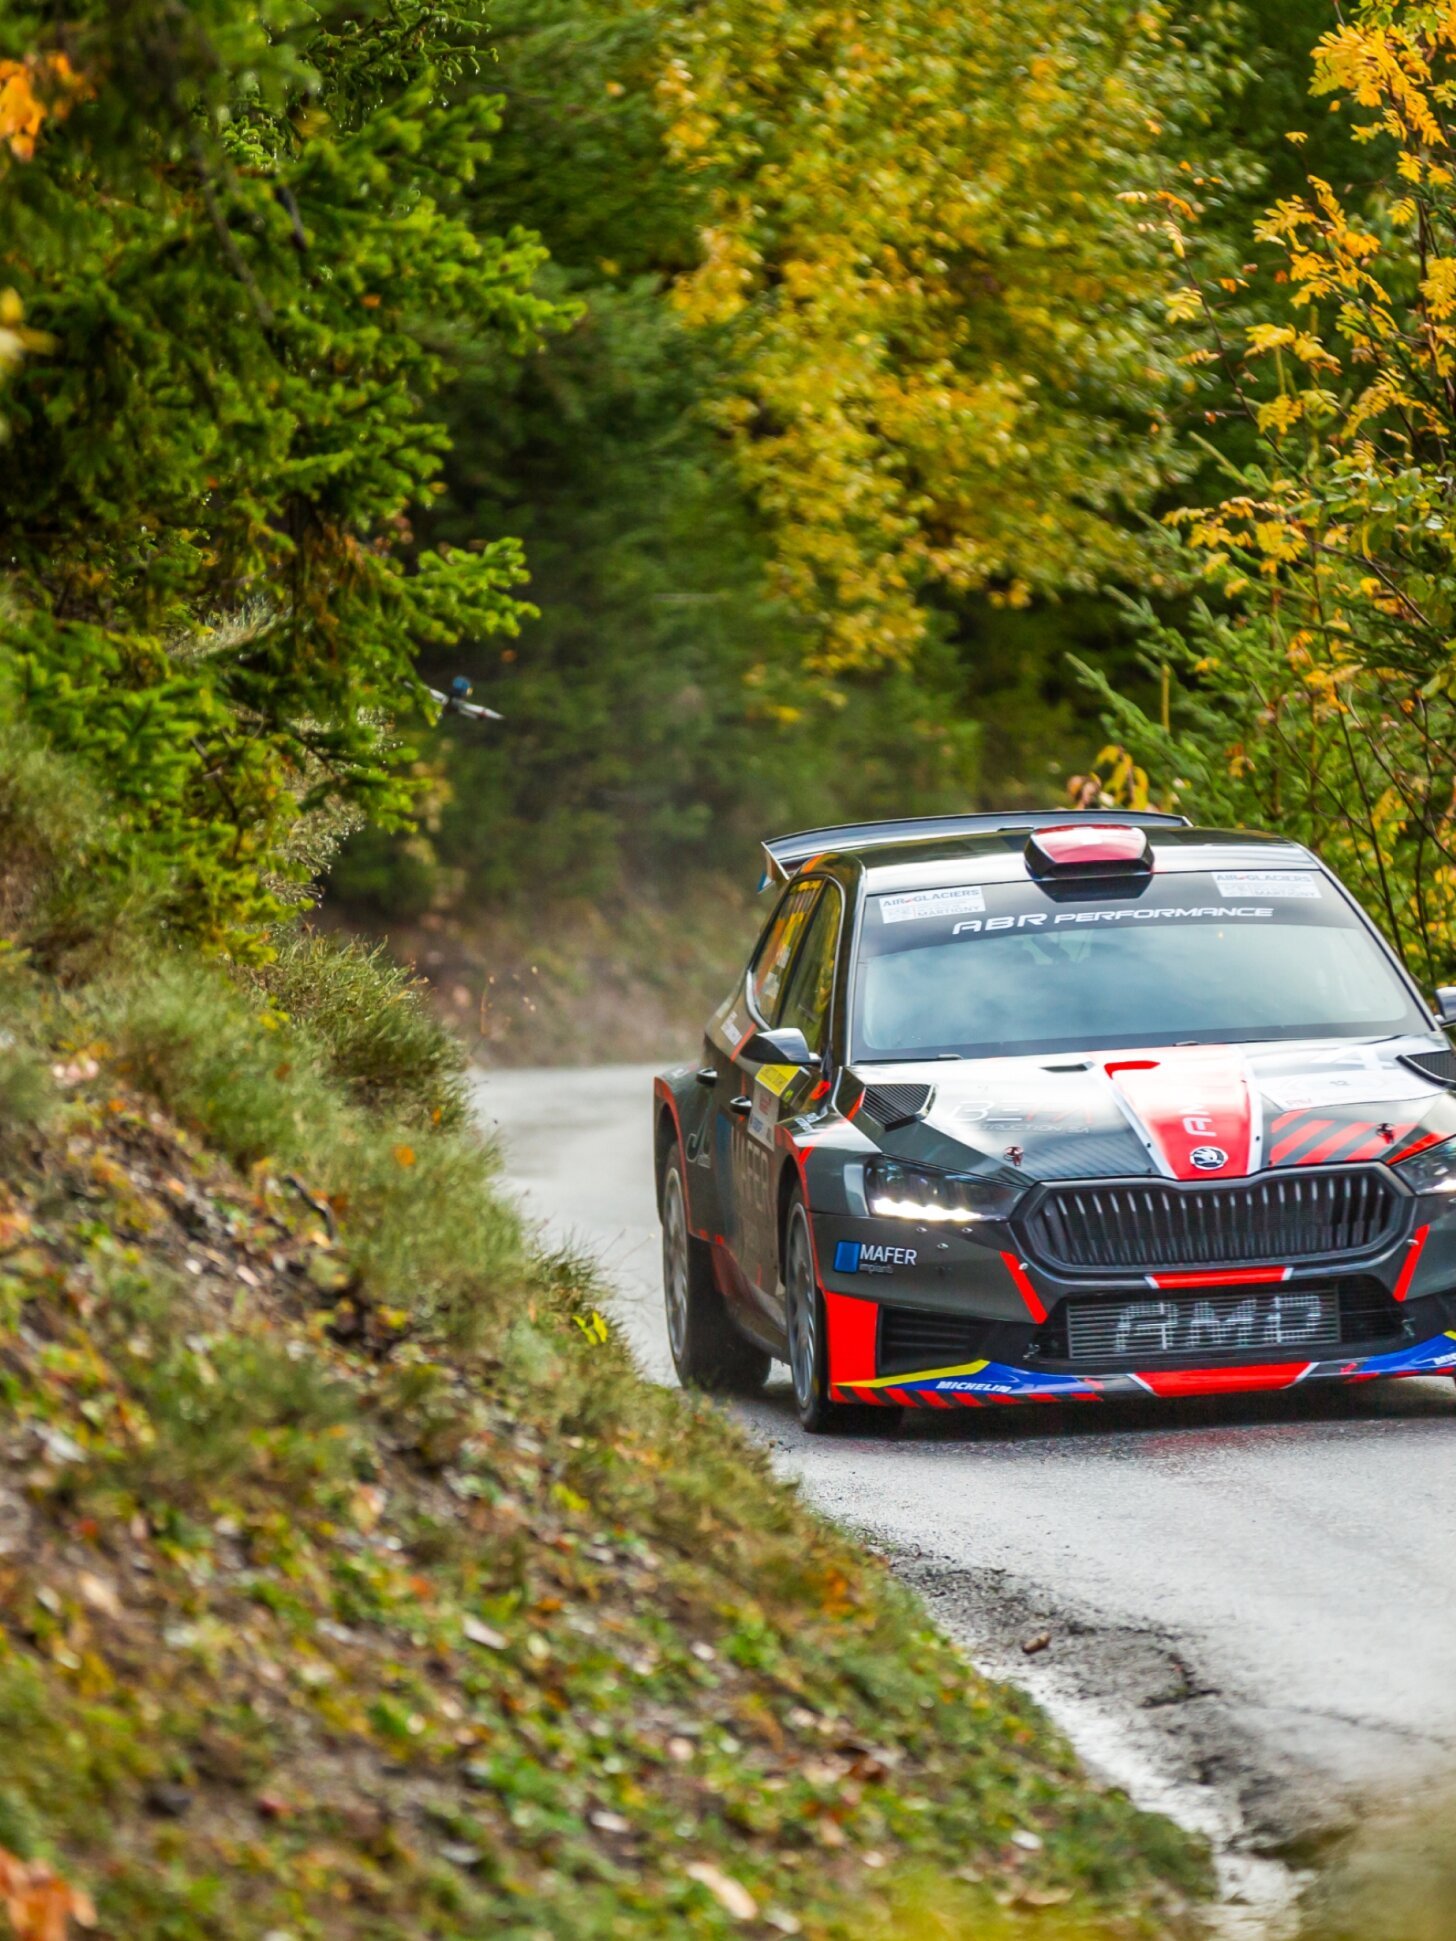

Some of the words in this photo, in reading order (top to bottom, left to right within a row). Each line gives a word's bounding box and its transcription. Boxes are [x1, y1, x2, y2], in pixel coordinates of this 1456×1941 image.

[952, 913, 1048, 935] ABR
[1053, 907, 1275, 924] PERFORMANCE
[859, 1243, 918, 1266] MAFER
[936, 1380, 1013, 1394] MICHELIN
